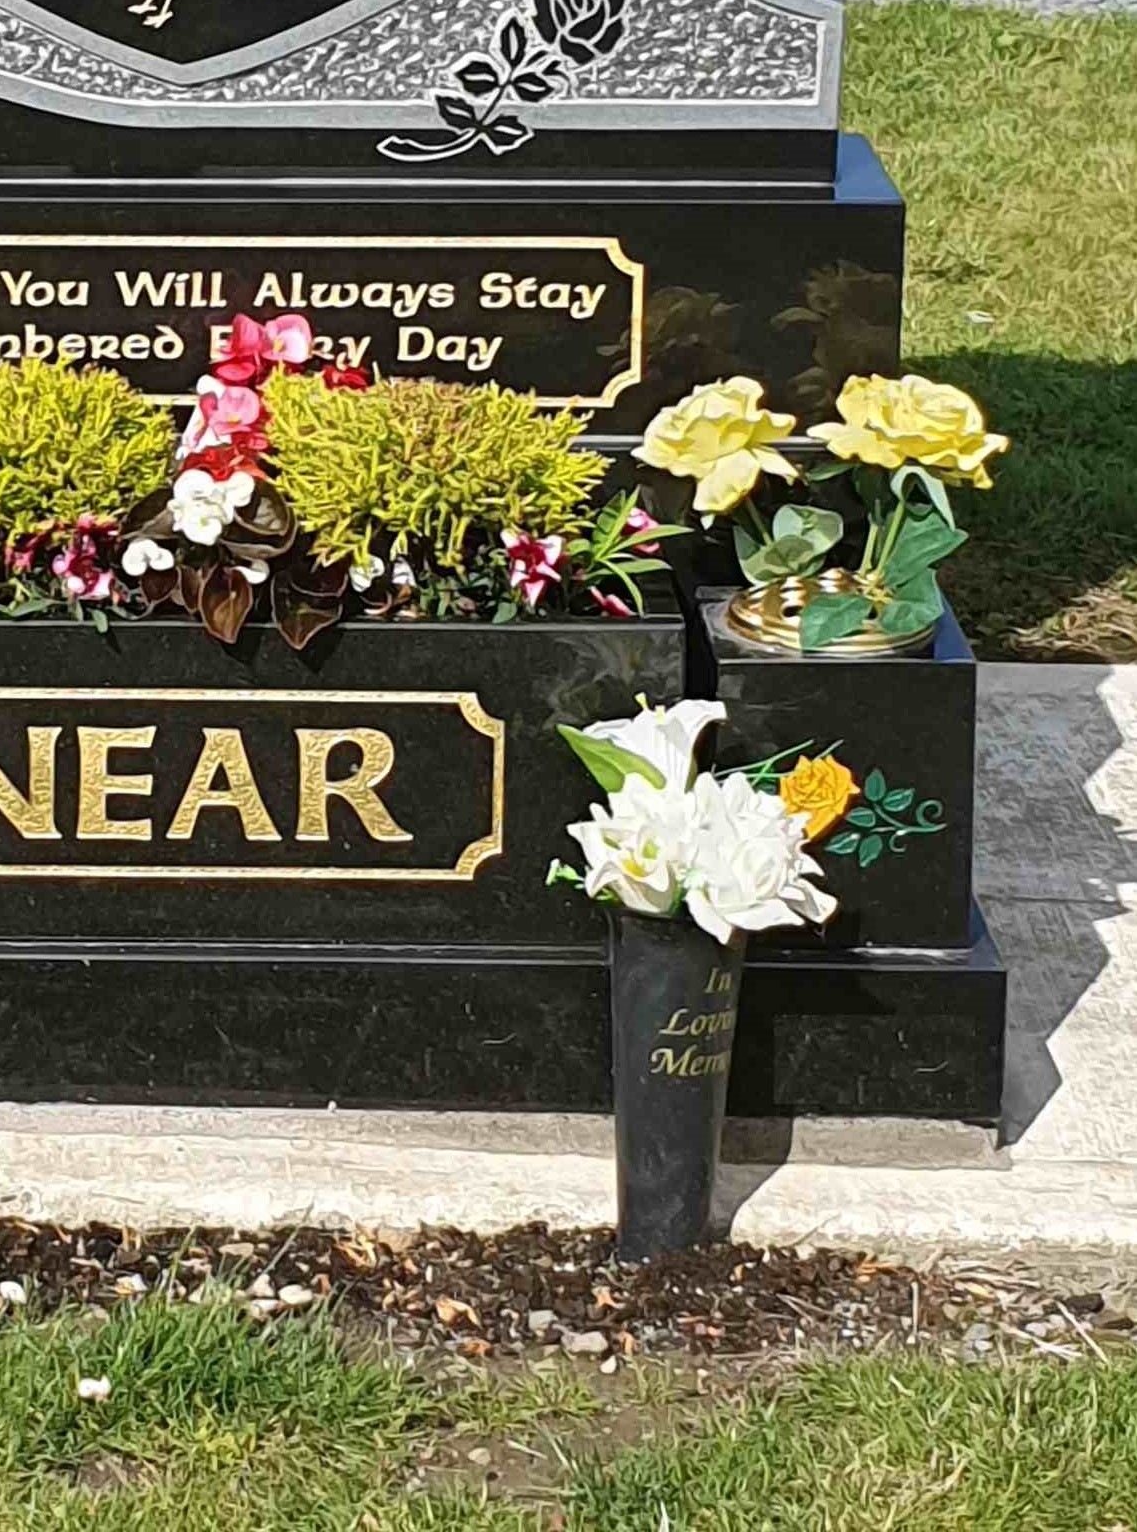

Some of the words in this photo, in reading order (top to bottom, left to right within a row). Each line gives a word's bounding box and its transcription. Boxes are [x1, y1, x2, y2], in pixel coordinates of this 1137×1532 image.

[0, 271, 89, 306] You
[115, 272, 227, 307] Will
[253, 272, 454, 317] Always
[480, 273, 606, 319] Stay
[397, 327, 502, 371] Day
[705, 968, 732, 993] In
